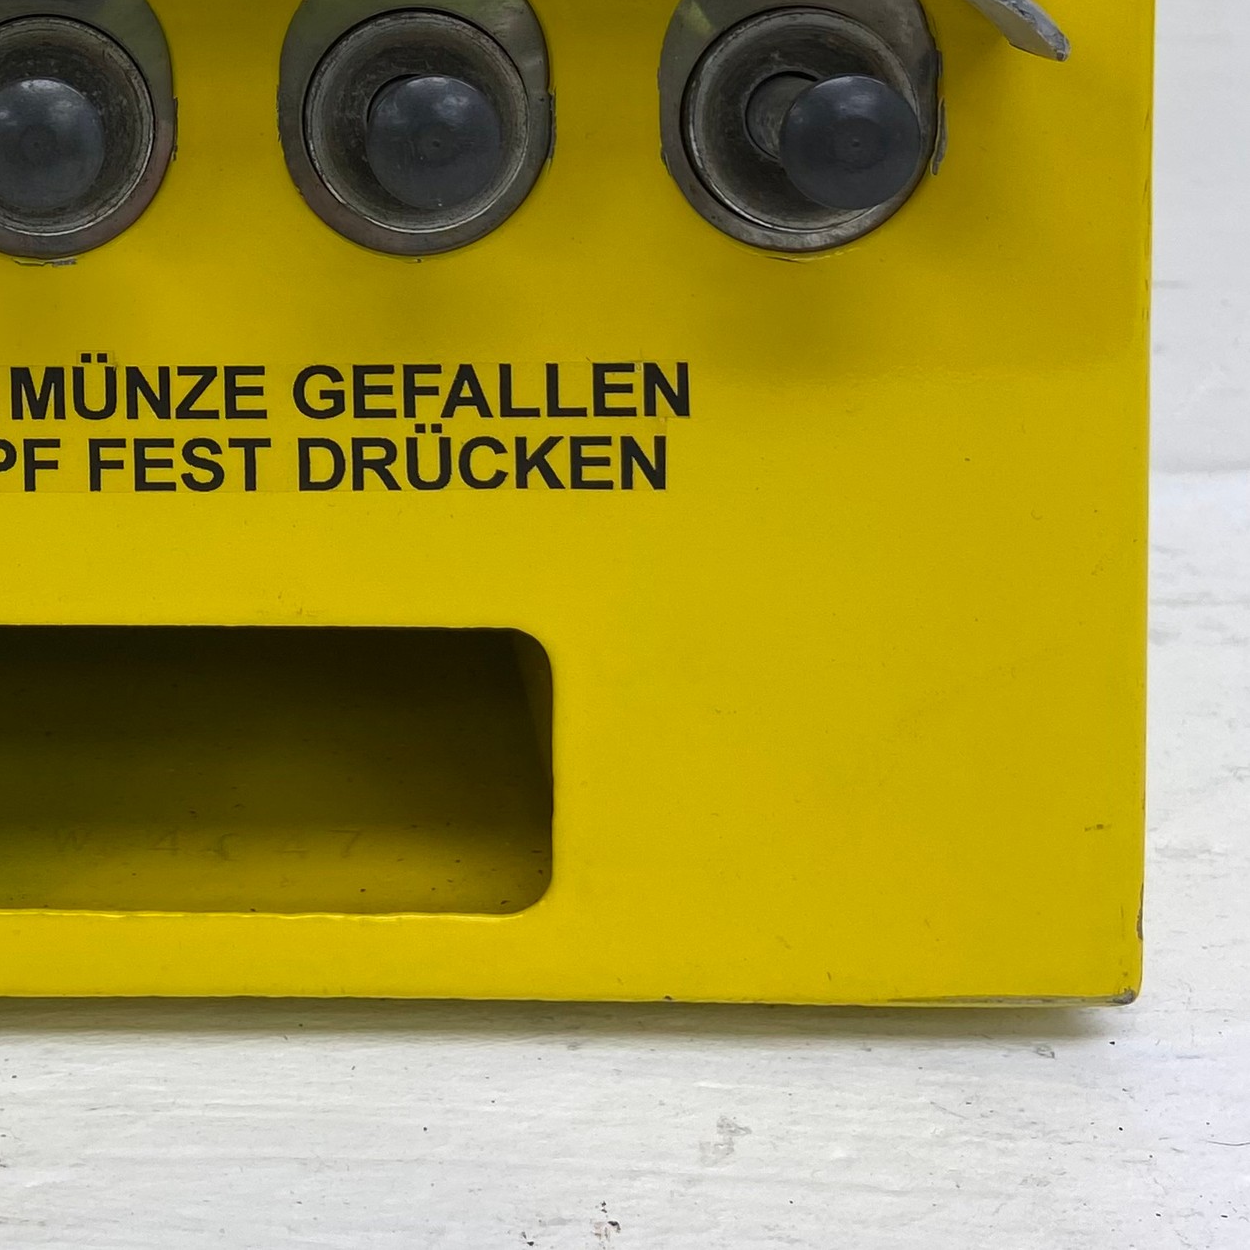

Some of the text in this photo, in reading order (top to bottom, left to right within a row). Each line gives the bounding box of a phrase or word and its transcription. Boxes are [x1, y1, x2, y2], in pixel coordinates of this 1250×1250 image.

[11, 353, 266, 419] MÜNZE
[293, 362, 689, 418] GEFALLEN
[89, 438, 270, 490] FEST
[298, 424, 666, 490] DRÜCKEN
